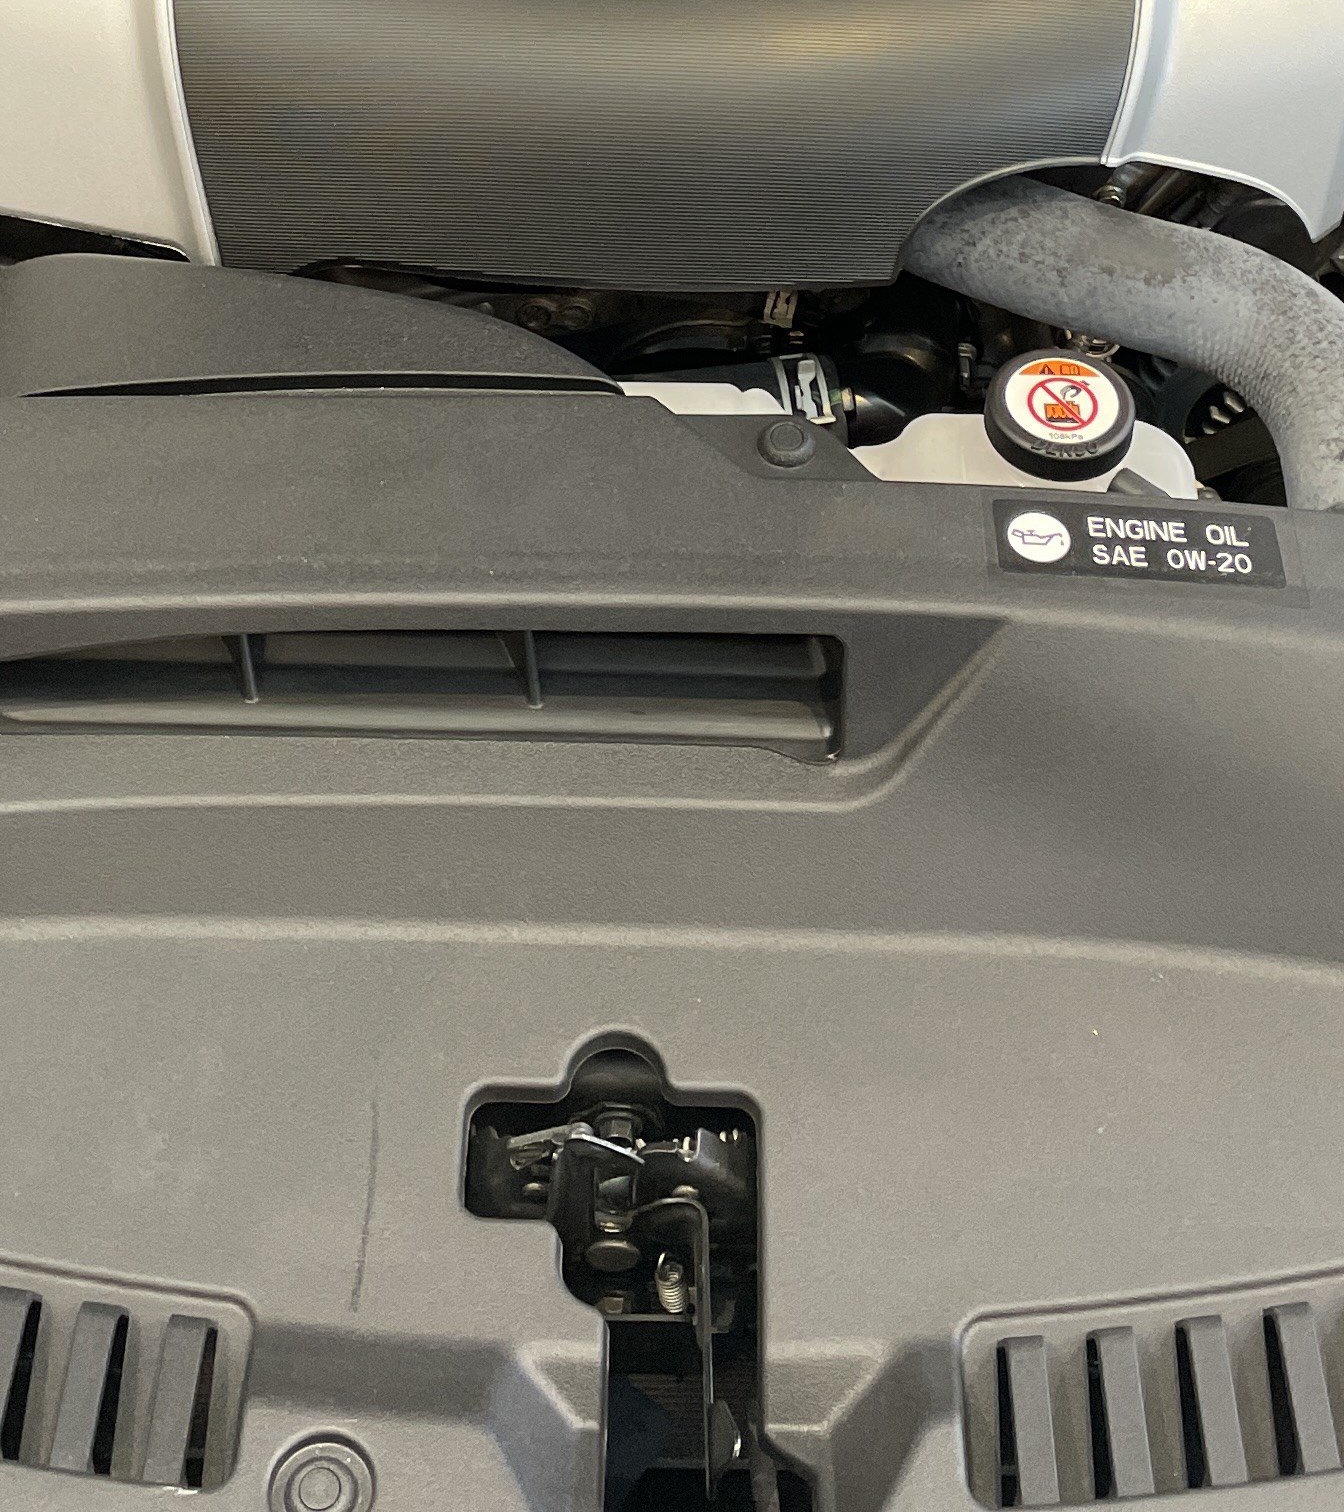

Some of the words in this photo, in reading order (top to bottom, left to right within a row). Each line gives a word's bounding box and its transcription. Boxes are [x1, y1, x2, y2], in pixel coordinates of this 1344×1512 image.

[1086, 515, 1188, 544] ENGINE
[1205, 523, 1250, 548] OIL
[1092, 543, 1149, 568] SAE
[1166, 547, 1254, 575] 0W-20
